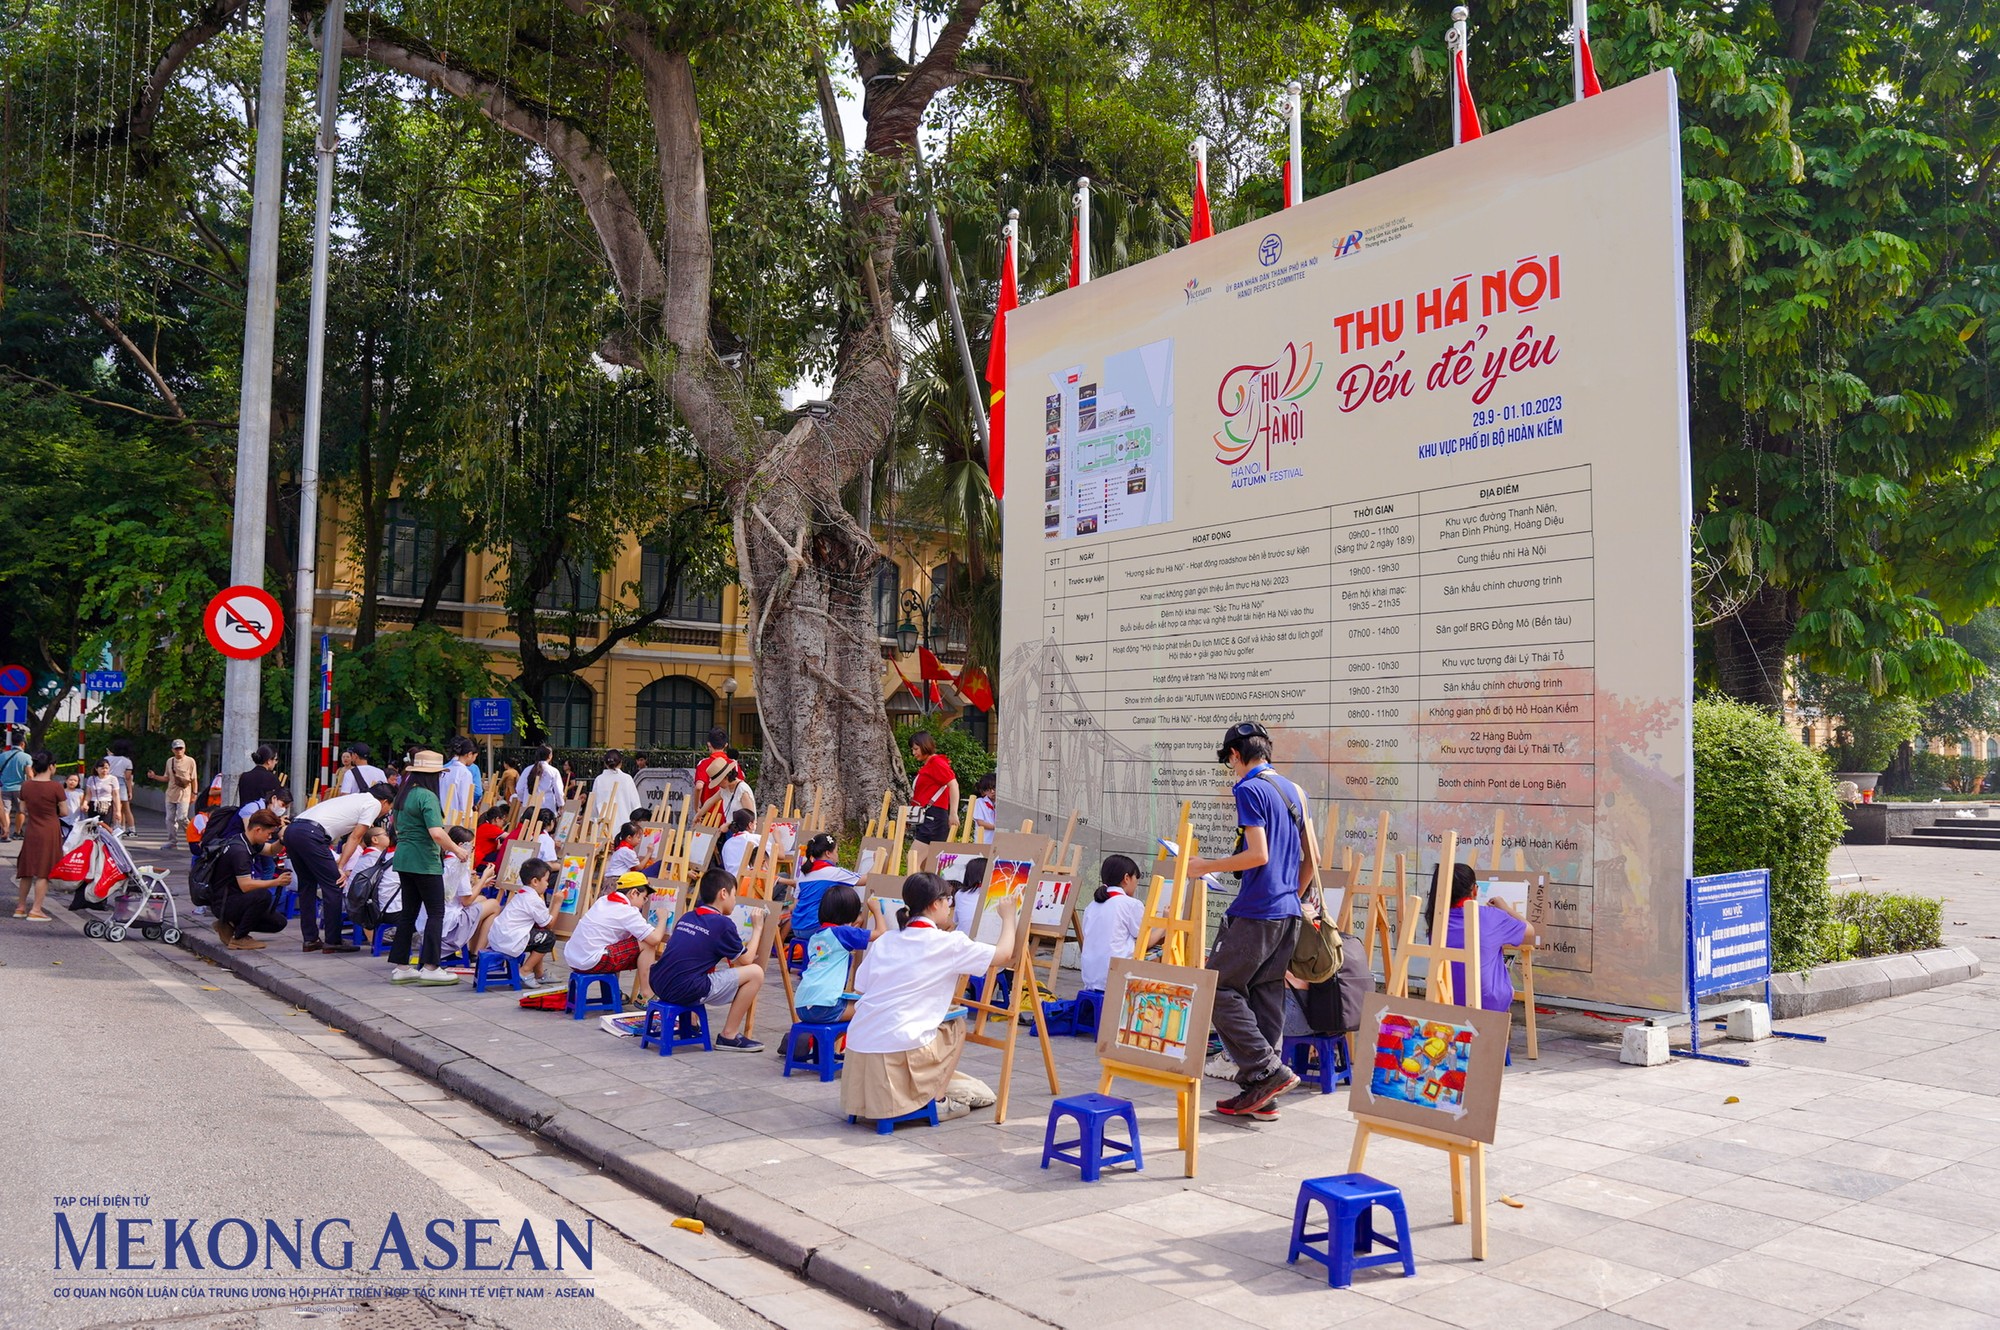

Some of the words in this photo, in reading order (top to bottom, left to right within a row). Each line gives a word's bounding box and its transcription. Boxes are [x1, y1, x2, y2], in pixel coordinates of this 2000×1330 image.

[1238, 289, 1252, 298] HANOI
[1254, 281, 1275, 293] PEOPLE'S
[1277, 271, 1305, 286] COMMITTEE
[1334, 299, 1404, 354] THU
[1336, 350, 1415, 413] Đến
[1426, 324, 1488, 391] để
[1472, 325, 1560, 405] yêu
[1473, 410, 1494, 427] 29.9
[1504, 396, 1562, 421] 01.10.2023
[1419, 442, 1437, 459] KHU
[1439, 440, 1457, 457] VỰC
[1460, 431, 1480, 451] PHỐ
[1481, 433, 1490, 448] ĐI
[1492, 429, 1505, 447] BỘ
[1508, 424, 1534, 443] HOÀN
[1537, 415, 1562, 438] KIẾM
[1231, 463, 1261, 478] HANOI
[1231, 475, 1266, 489] AUTUMN
[1270, 467, 1303, 482] FESTIVAL
[1480, 489, 1495, 499] ĐỊA
[1497, 484, 1519, 495] ĐIỂM
[1354, 507, 1376, 517] THỜI
[1375, 505, 1393, 515] GIAN
[1446, 518, 1460, 526] Khu
[1463, 516, 1477, 524] vực
[1480, 512, 1506, 522] đường
[1508, 506, 1533, 517] Thanh
[1536, 504, 1557, 516] Niên,
[1349, 529, 1369, 540] 09h00
[1378, 525, 1399, 535] 11h00
[1440, 531, 1459, 539] Phan
[1462, 527, 1480, 537] Đình
[1514, 520, 1541, 529] Hoàng
[1545, 516, 1564, 526] Diệu
[1193, 534, 1209, 543] HOẠT
[1212, 531, 1231, 540] ĐỘNG
[1457, 555, 1478, 564] Cung
[1481, 550, 1500, 561] thiếu
[1503, 549, 1515, 558] nhi
[1518, 547, 1529, 557] Hà
[1532, 545, 1546, 556] Nội
[1350, 566, 1370, 576] 19h00
[1378, 563, 1399, 572] 19h30
[1444, 586, 1459, 595] Sân
[1462, 582, 1480, 593] khấu
[1483, 581, 1505, 591] chính
[1508, 579, 1540, 588] chương
[1543, 575, 1562, 585] trình
[1349, 601, 1369, 610] 19h35
[1378, 598, 1400, 608] 21h35
[1436, 625, 1451, 634] Sân
[1454, 623, 1468, 635] golf
[1470, 622, 1489, 631] BRG
[1492, 619, 1513, 630] Đồng
[1516, 618, 1529, 627] Mô
[1532, 617, 1551, 628] (Bến
[1555, 616, 1571, 625] tàu)
[1460, 659, 1475, 667] vực
[1477, 657, 1501, 666] tượng
[1504, 655, 1516, 663] đài
[1519, 654, 1529, 664] Lý
[1532, 653, 1550, 661] Thái
[1553, 650, 1564, 660] Tổ
[1216, 692, 1247, 700] WEDDING
[1249, 691, 1279, 699] FASHION
[1430, 708, 1454, 718] Không
[1456, 707, 1473, 718] gian
[1476, 705, 1491, 717] phố
[1493, 706, 1500, 715] đi
[1503, 706, 1513, 715] bộ
[1516, 704, 1528, 714] Hồ
[1531, 705, 1553, 713] Hoàn
[1556, 702, 1578, 713] Kiếm
[1471, 732, 1480, 740] 22
[1483, 732, 1504, 743] Hàng
[1508, 730, 1531, 740] Buồm
[1346, 776, 1367, 785] 09h00
[1376, 777, 1398, 785] 22h00
[1439, 778, 1461, 787] Booth
[1463, 779, 1485, 787] chính
[1488, 779, 1507, 788] Pont
[1510, 779, 1520, 788] de
[1523, 780, 1544, 791] Long
[1547, 780, 1566, 789] Biên
